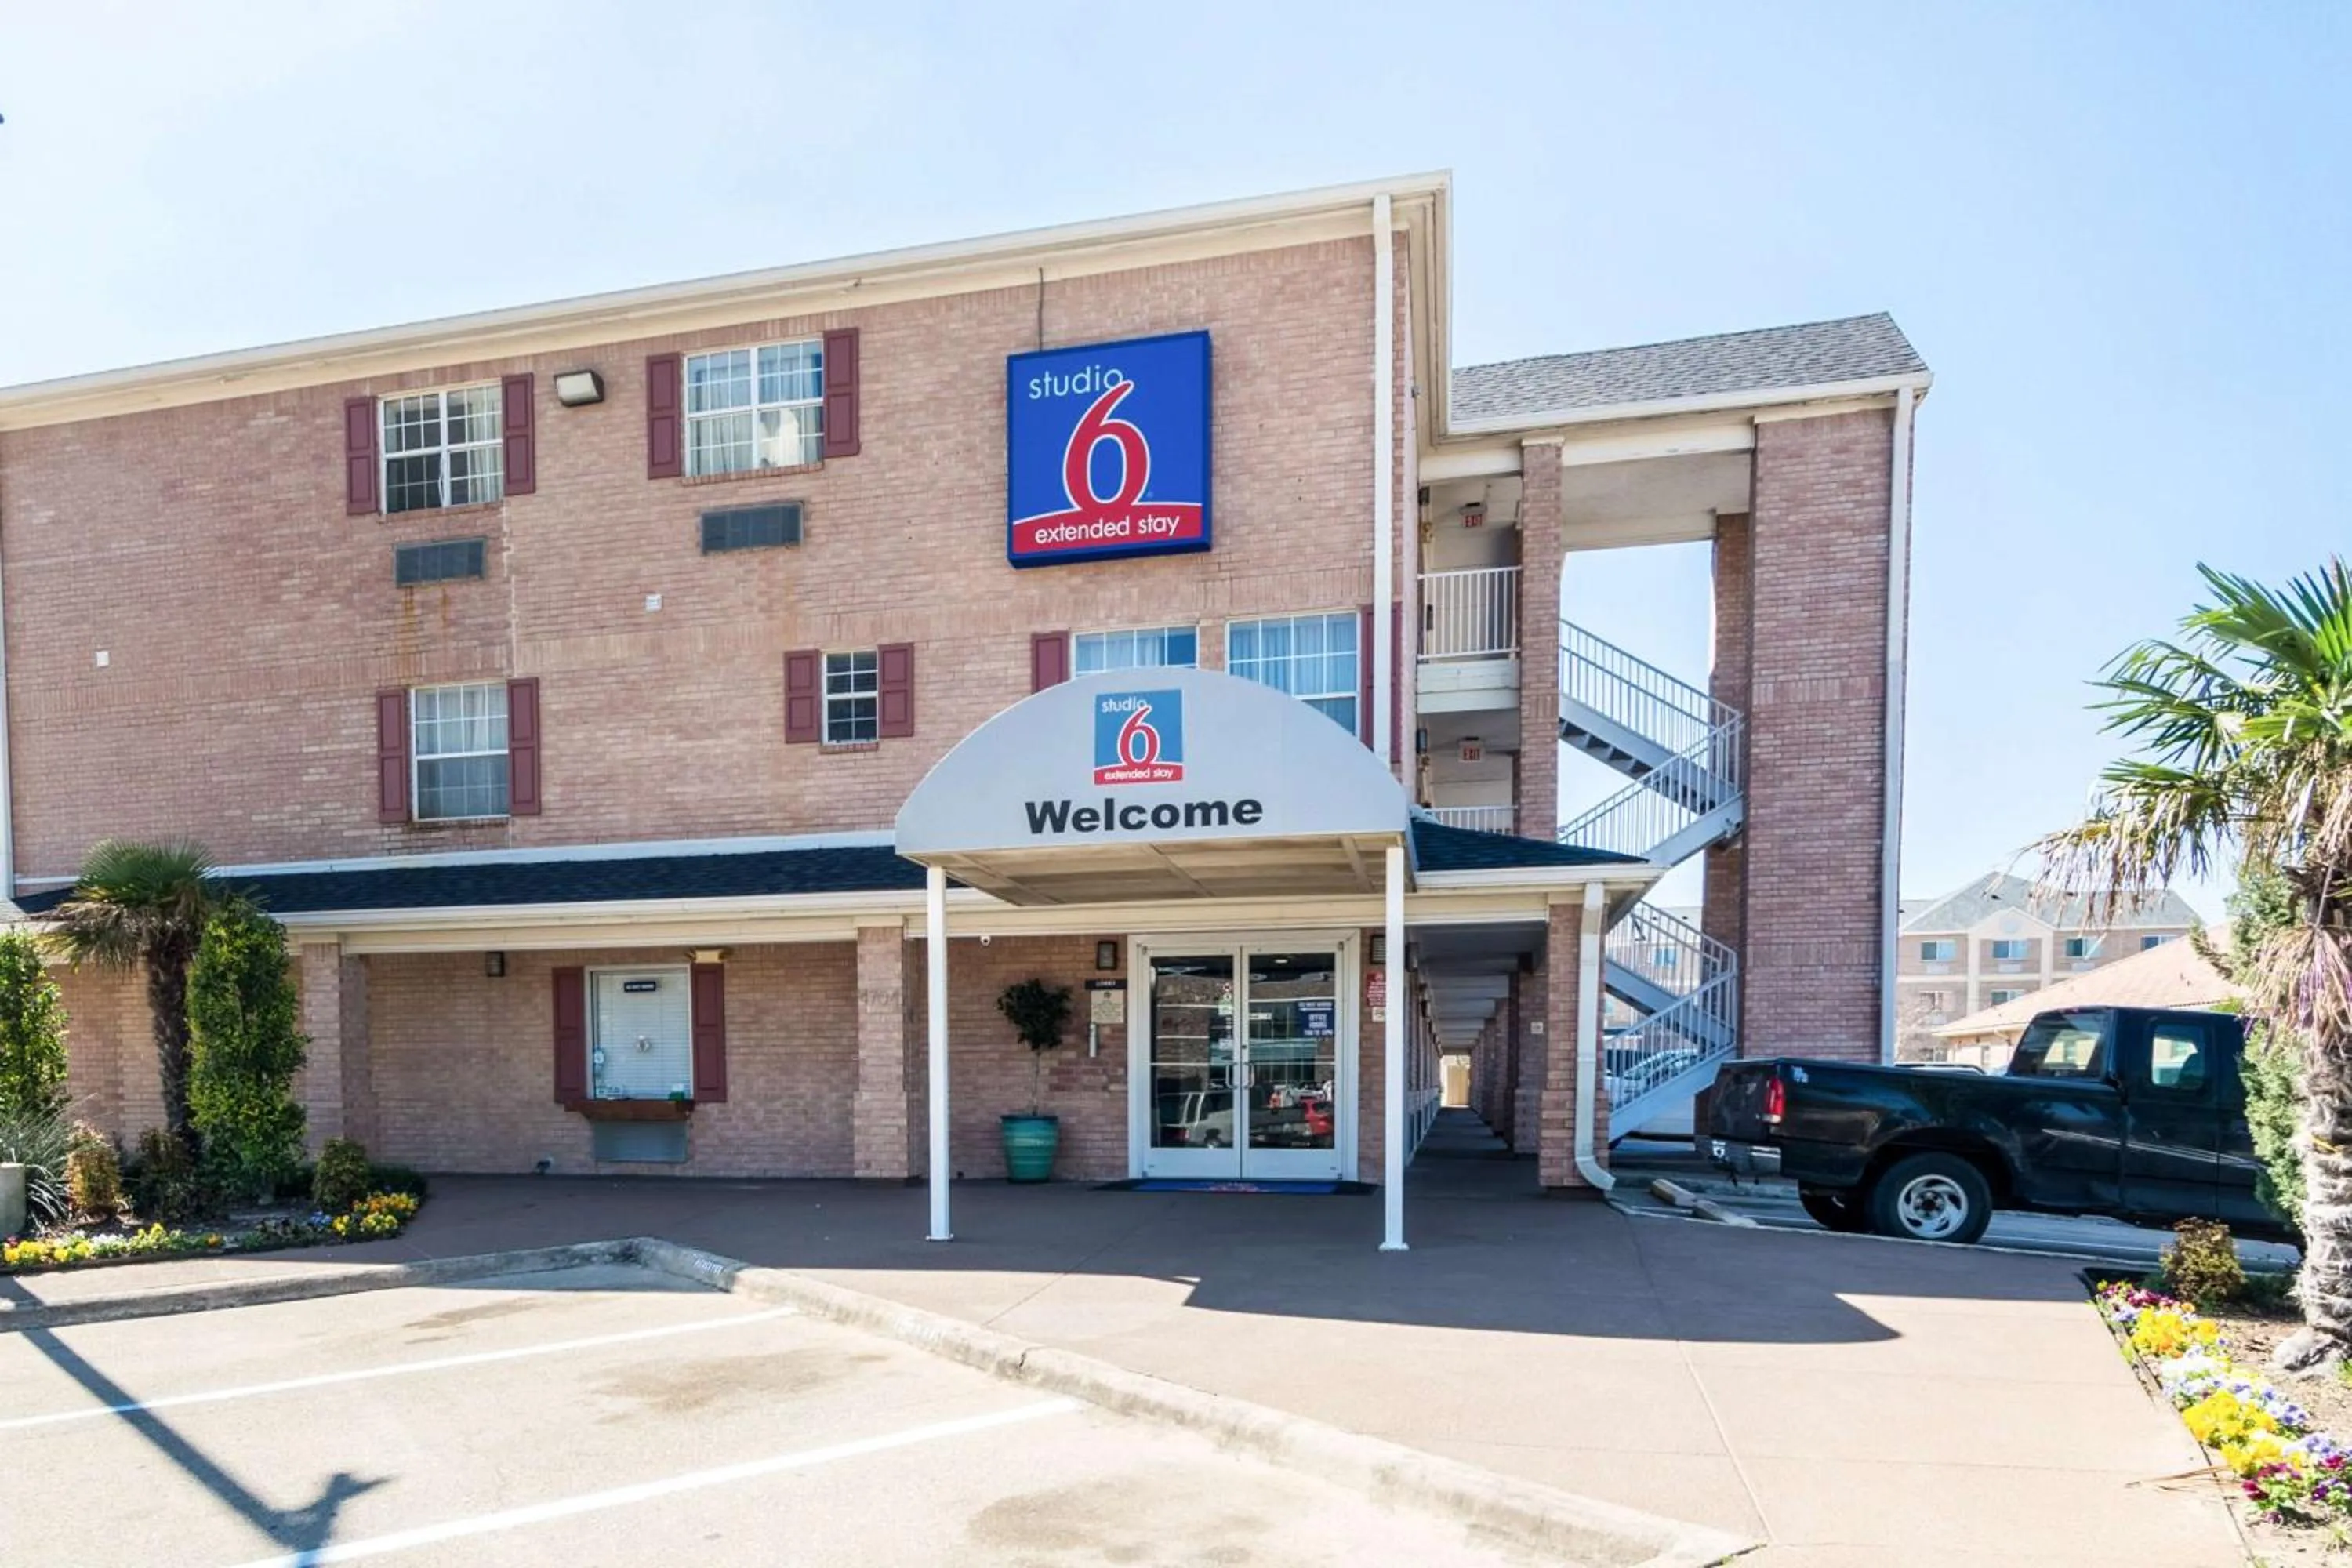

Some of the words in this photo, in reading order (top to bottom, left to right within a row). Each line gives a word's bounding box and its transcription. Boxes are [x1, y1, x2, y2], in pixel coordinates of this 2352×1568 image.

[1029, 365, 1123, 399] studio
[1062, 380, 1151, 510] 6
[1035, 516, 1129, 544] extended
[1138, 514, 1180, 535] stay
[1102, 696, 1148, 713] studio
[1117, 705, 1160, 765] 6
[1105, 768, 1150, 781] extended
[1153, 768, 1174, 779] stay
[1025, 797, 1263, 835] Welcome
